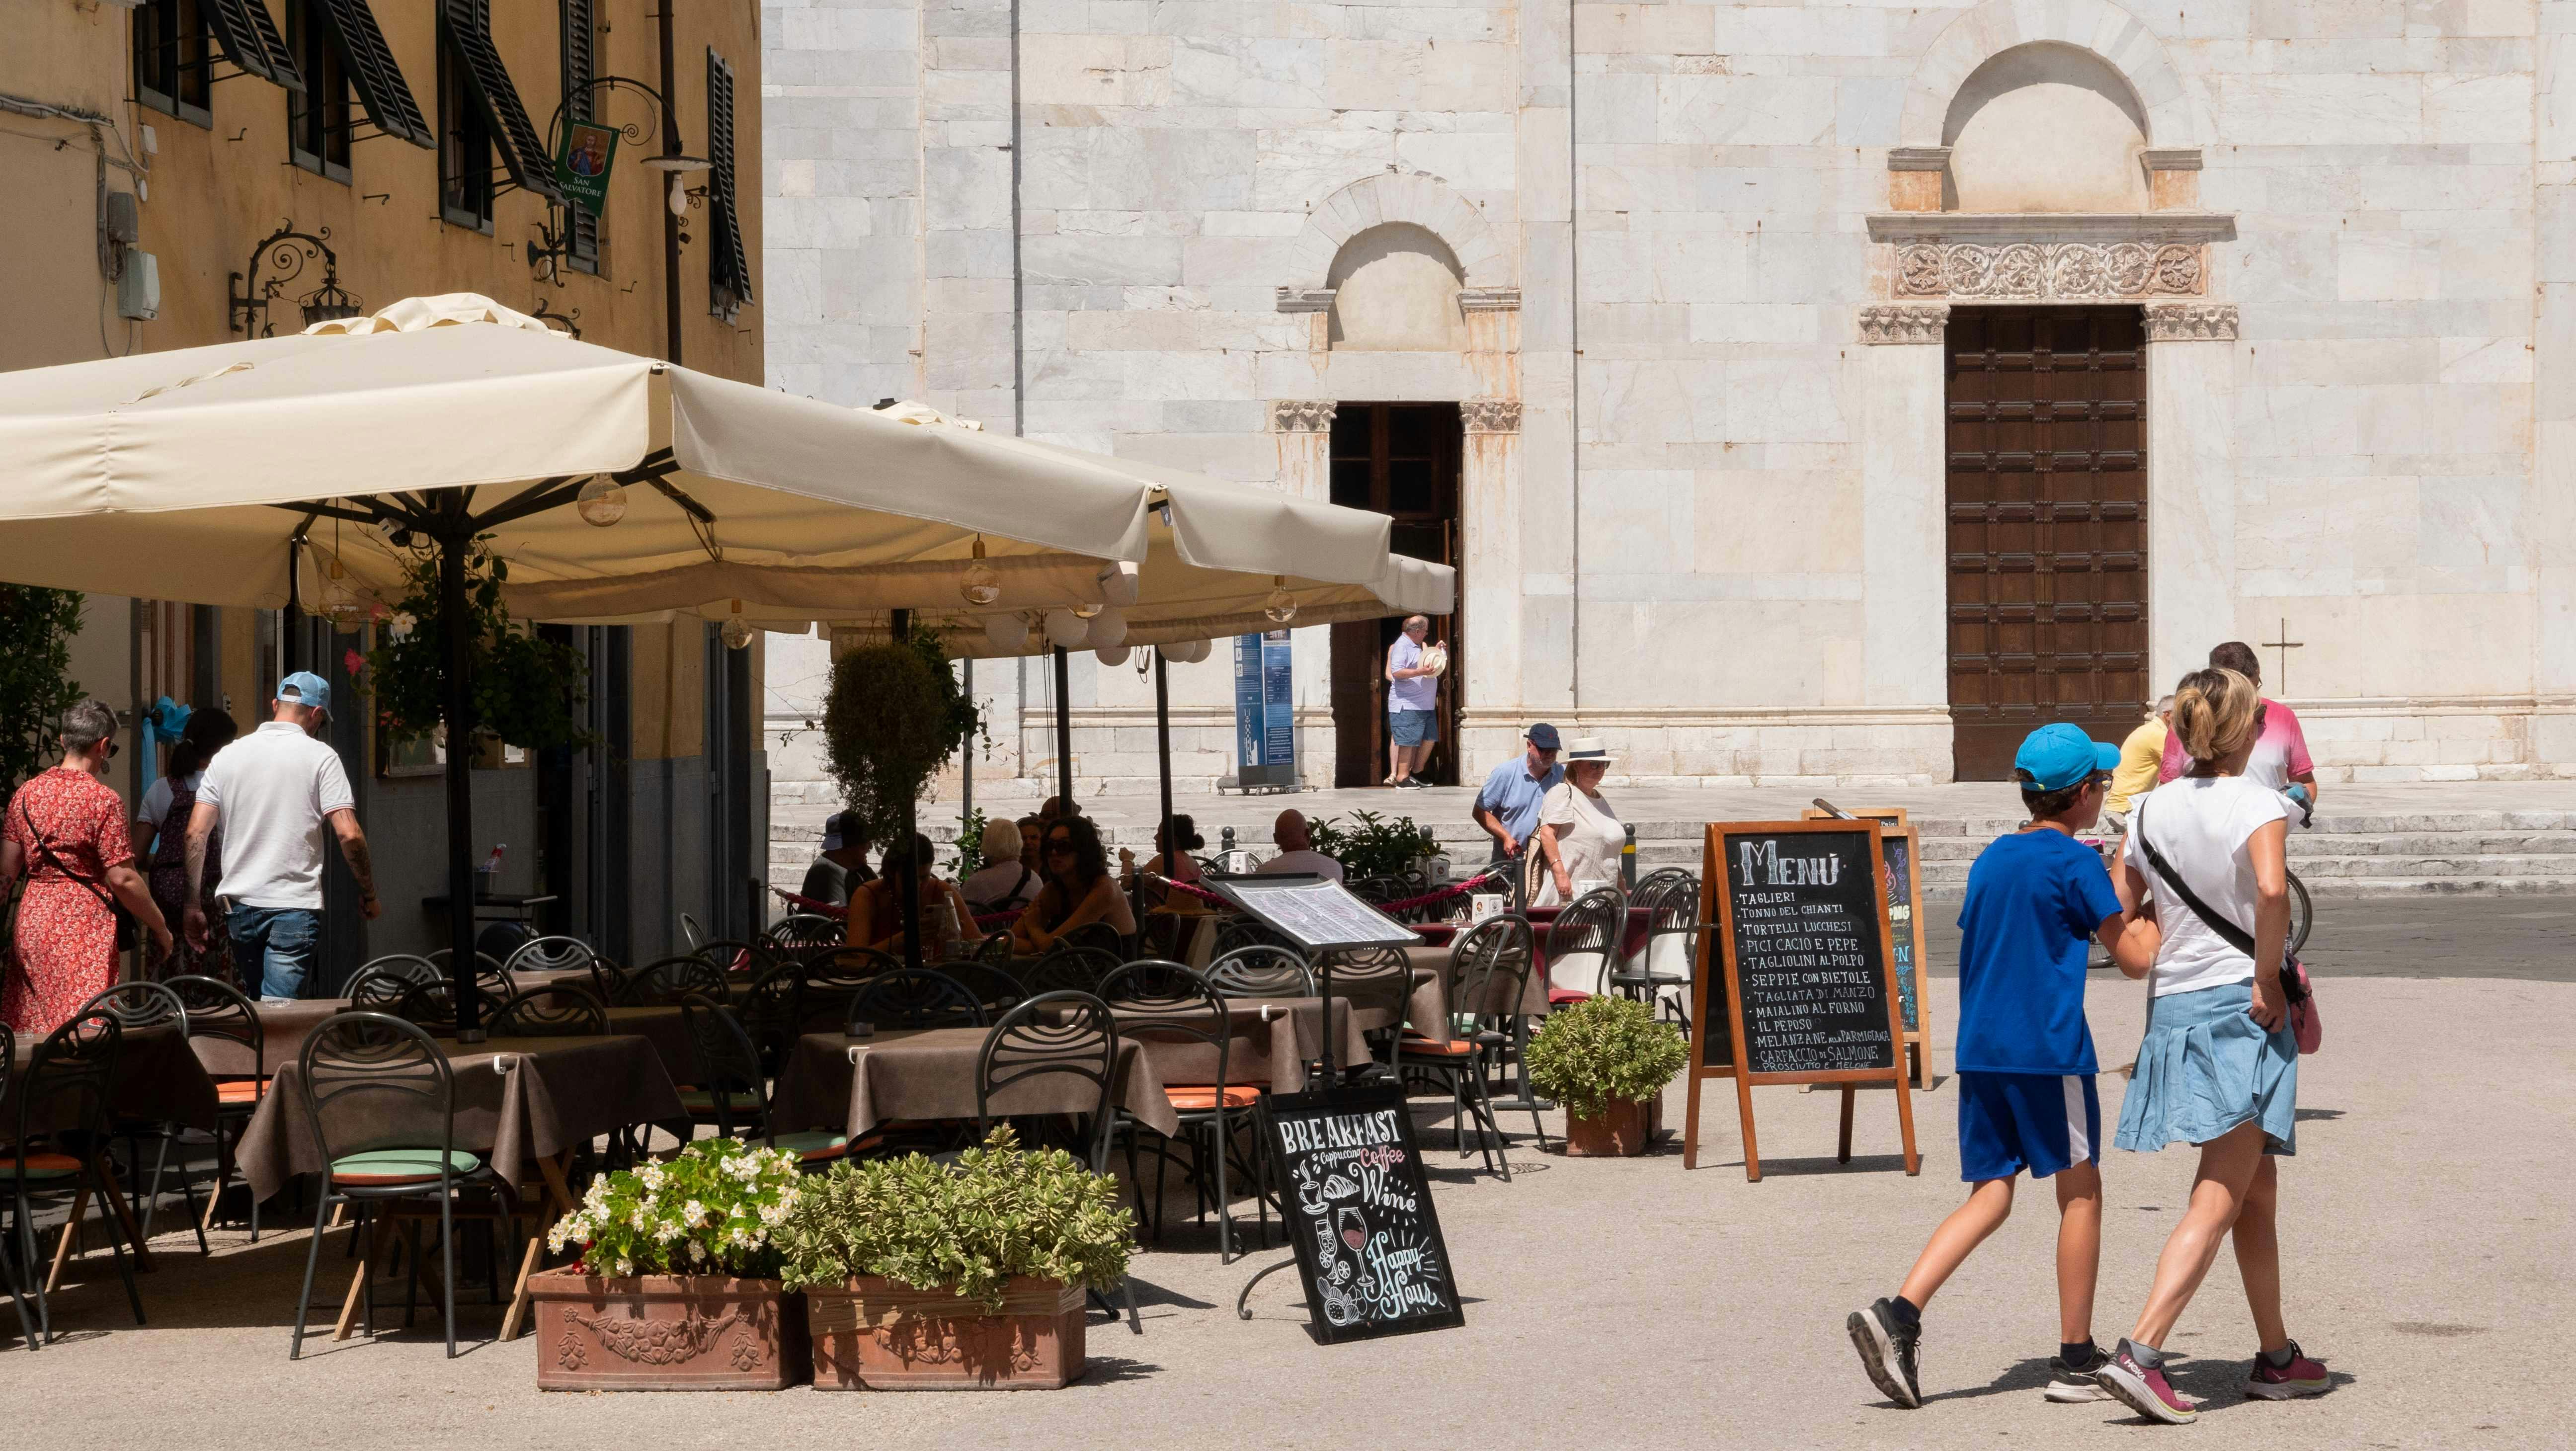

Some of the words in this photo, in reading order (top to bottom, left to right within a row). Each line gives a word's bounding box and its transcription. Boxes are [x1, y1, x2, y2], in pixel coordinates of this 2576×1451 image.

[559, 181, 602, 197] SALVATORE
[573, 176, 590, 186] SAN
[1739, 892, 1795, 905] TAGLIERI
[1741, 907, 1776, 919] TONNO
[1779, 906, 1798, 916] DEL
[1801, 904, 1844, 915] CHIANTI
[1743, 922, 1799, 935] TORTELLI
[1804, 921, 1852, 933] LUCCHESI
[1747, 939, 1771, 953] PICI
[1776, 938, 1812, 951] CACIO
[1814, 938, 1824, 950] E
[1827, 938, 1858, 951] PEPE
[1748, 955, 1816, 969] TAGLIOLINI
[1820, 955, 1831, 966] AL
[1831, 954, 1864, 967] POLPO
[1752, 972, 1799, 986] SEPPIE
[1821, 971, 1870, 984] BIETOLE
[1754, 989, 1814, 1003] TAGLIATA
[1816, 988, 1829, 999] DI
[1833, 986, 1875, 999] MANZO
[1756, 1004, 1809, 1018] MAIALINO
[1812, 1003, 1826, 1014] AL
[1828, 1002, 1864, 1014] FORNO
[1759, 1021, 1771, 1032] IL
[1774, 1019, 1813, 1032] PEPOSO
[1757, 1032, 1827, 1048] MELANZANE
[1841, 1030, 1890, 1043] PARMIGIANA
[1760, 1047, 1817, 1063] CARPACCIO
[1827, 1046, 1878, 1061] SALMONE
[1762, 1062, 1821, 1071] PROSCIUTTO
[1278, 1110, 1402, 1154] BREAKFAST
[1320, 1148, 1362, 1169] Cappuccino
[1360, 1145, 1405, 1173] Coffee
[1348, 1162, 1417, 1212] Wine
[1363, 1231, 1426, 1302] Happy
[1380, 1270, 1438, 1318] Hour
[2124, 1359, 2146, 1381] HOKA
